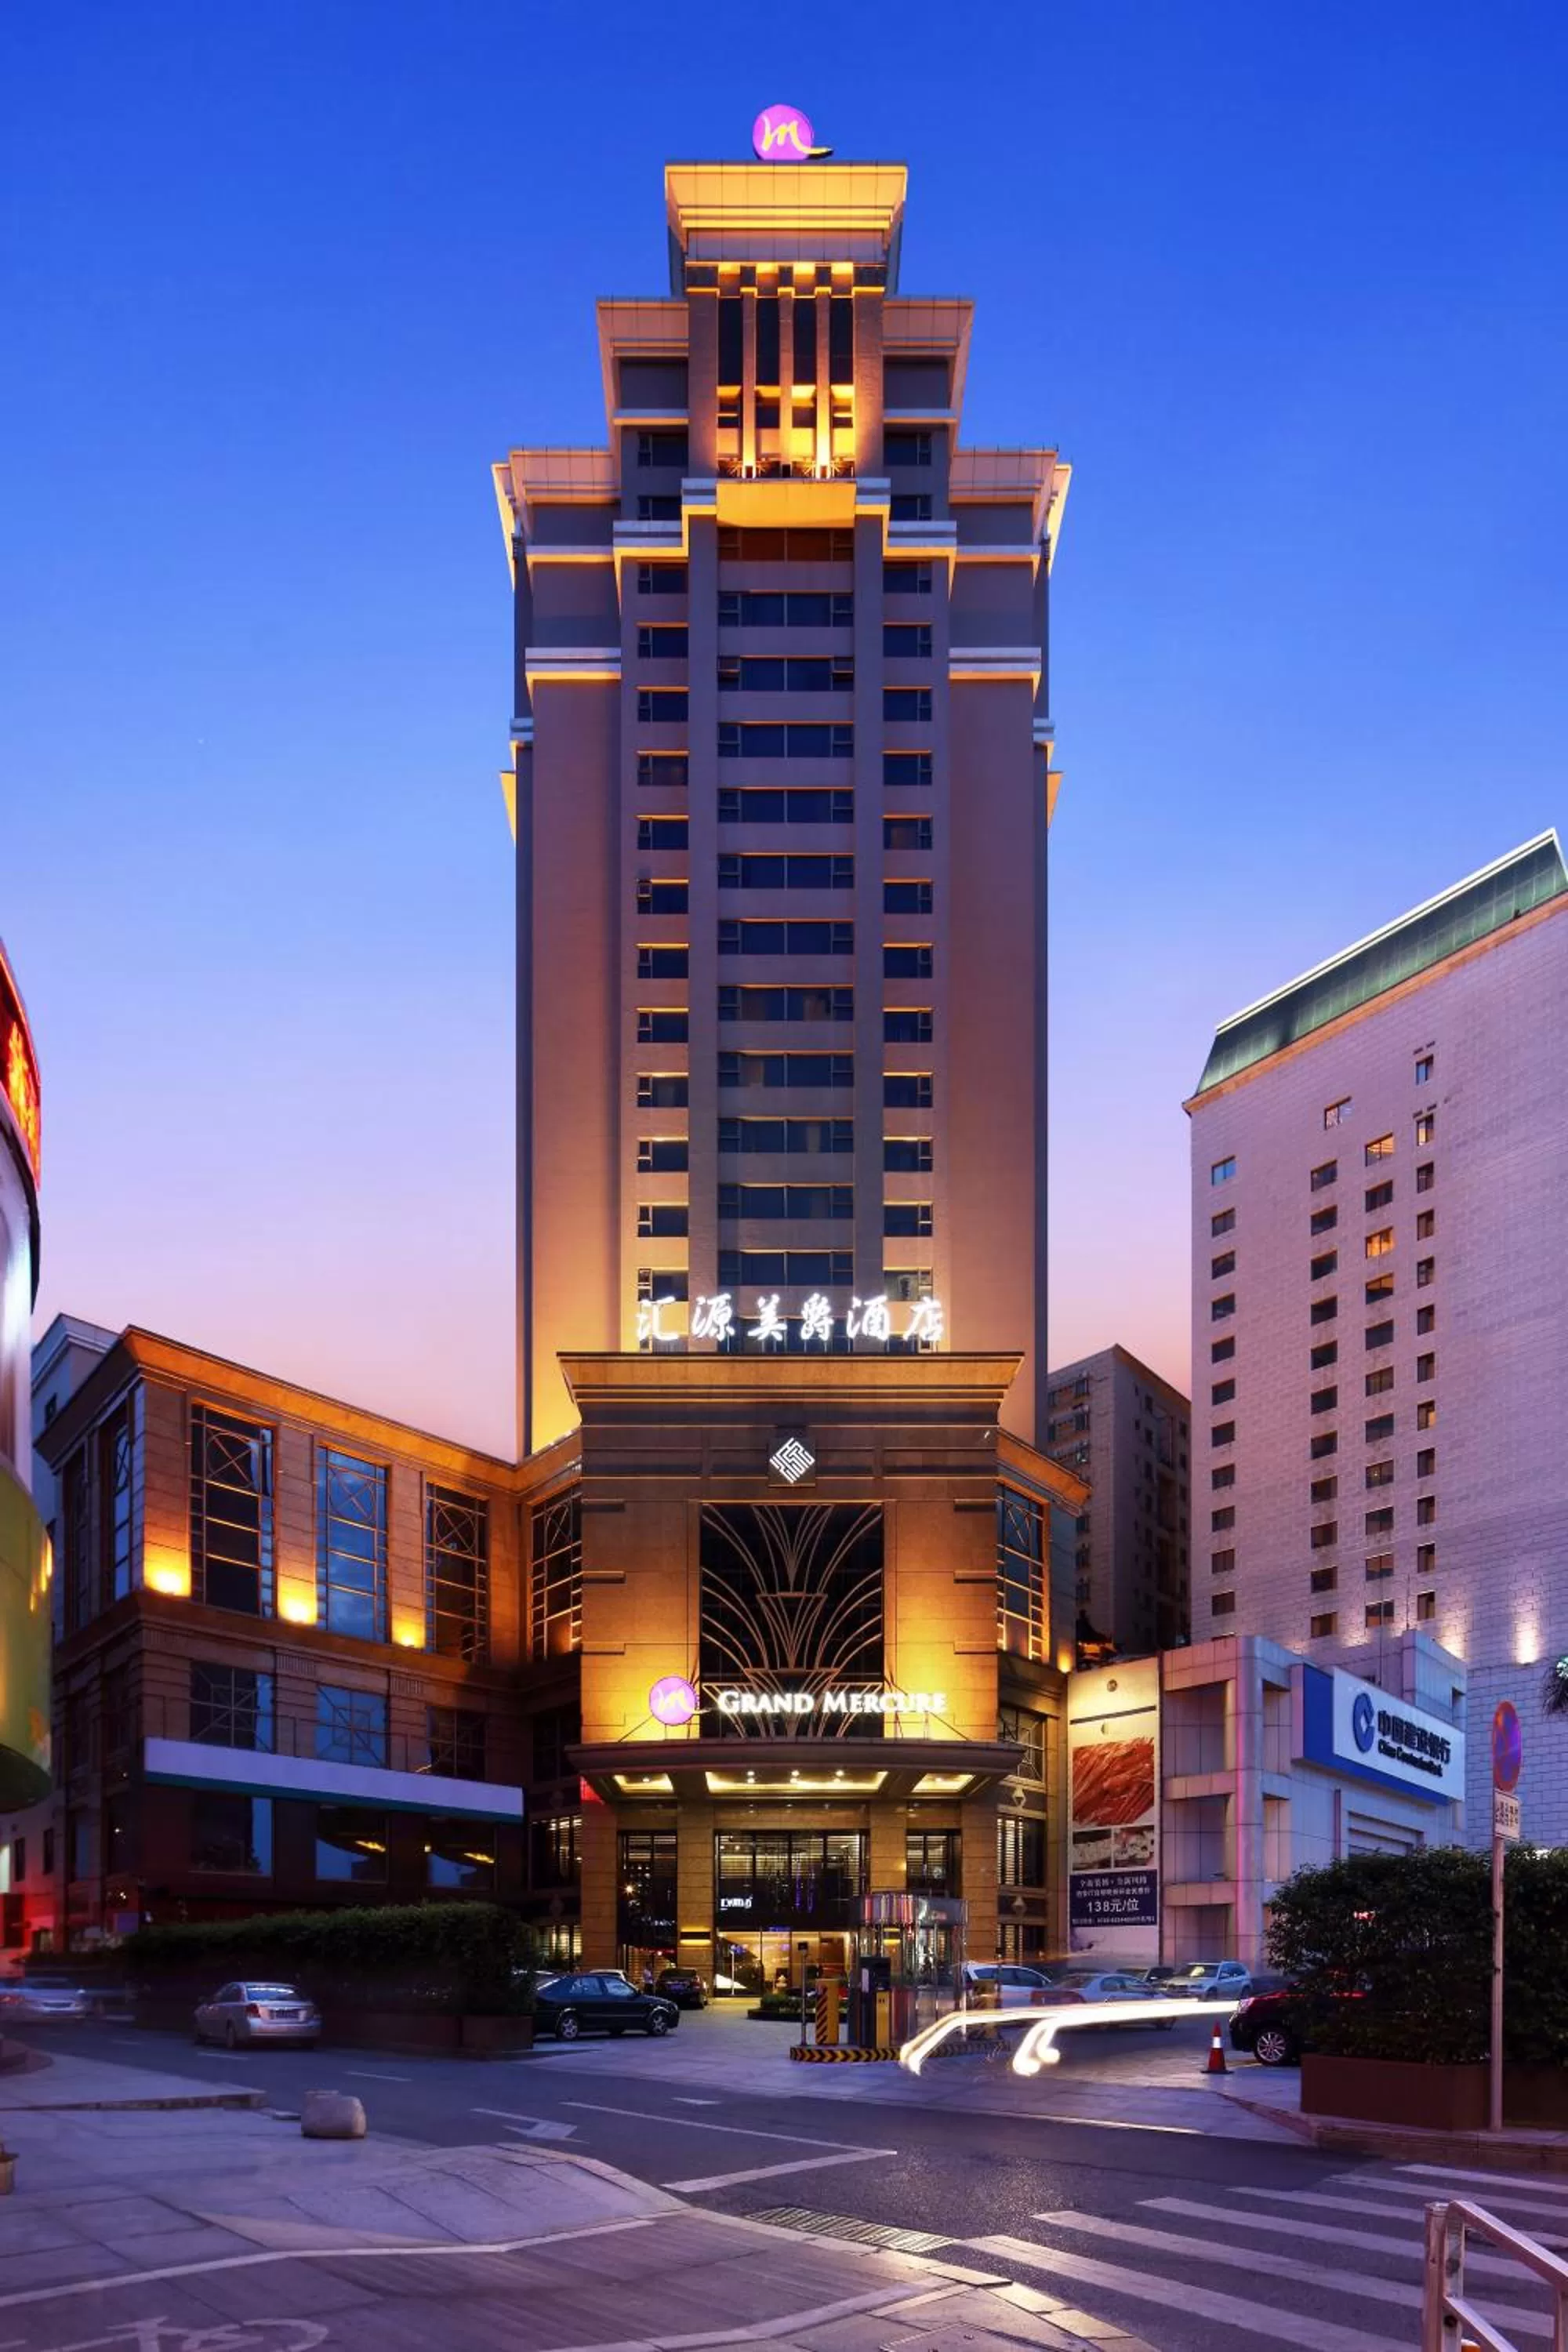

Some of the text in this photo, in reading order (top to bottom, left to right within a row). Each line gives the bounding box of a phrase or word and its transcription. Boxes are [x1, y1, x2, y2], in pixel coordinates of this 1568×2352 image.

[636, 1293, 946, 1342] 汇源美爵酒店
[718, 1690, 946, 1714] GRAND MERCURE
[1087, 1898, 1139, 1913] 138元/位
